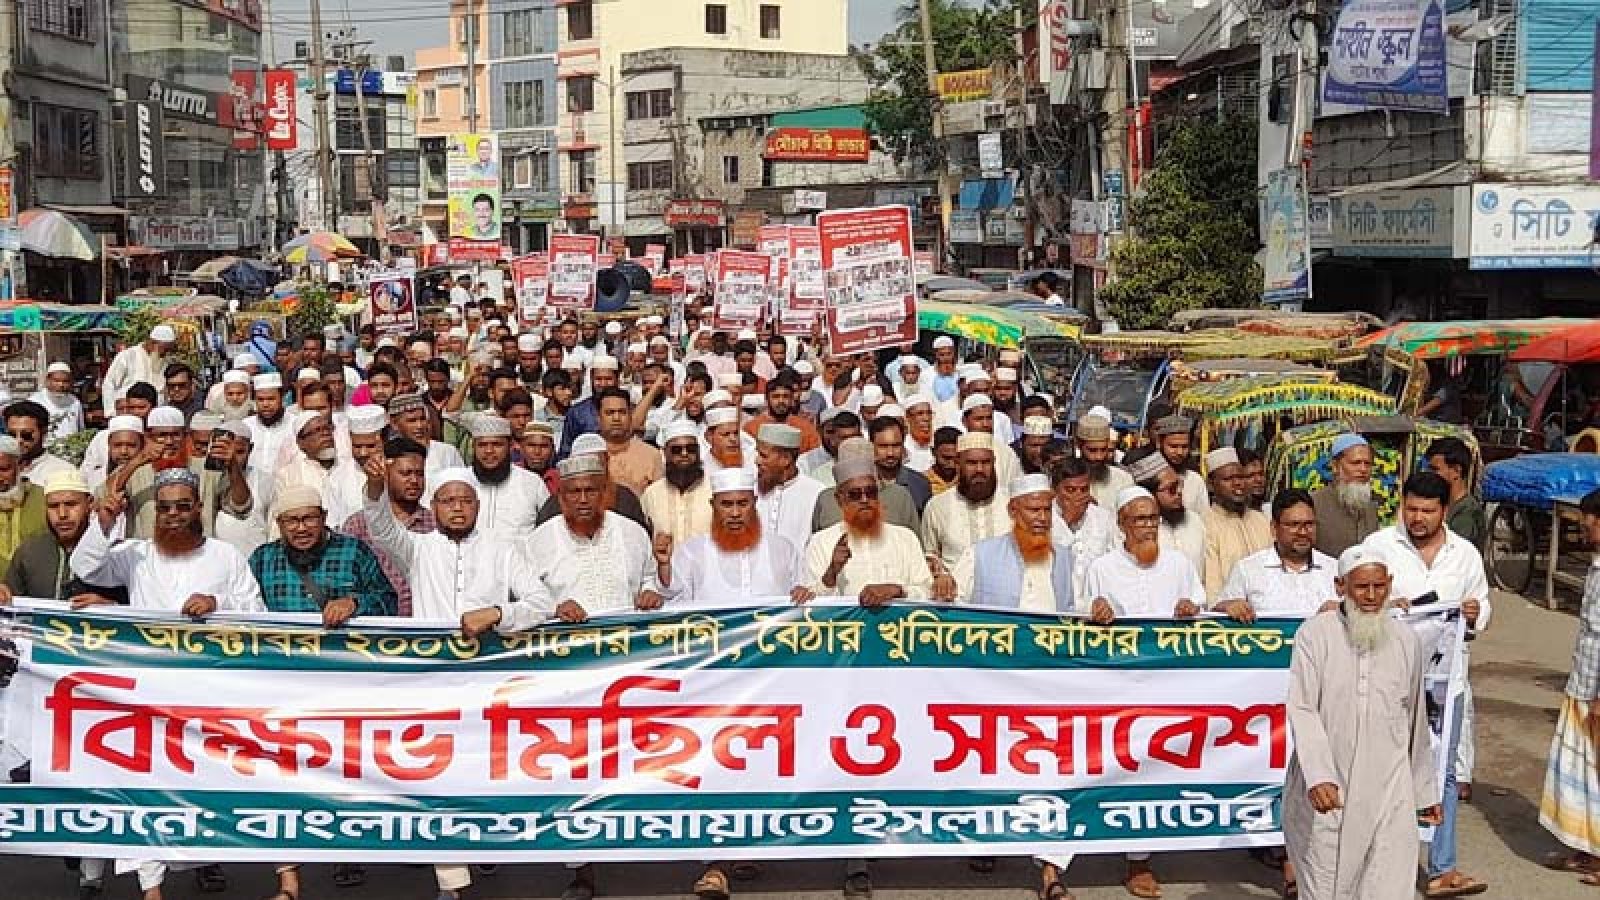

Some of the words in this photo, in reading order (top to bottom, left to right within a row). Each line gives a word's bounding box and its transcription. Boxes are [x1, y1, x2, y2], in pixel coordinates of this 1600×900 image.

[163, 87, 207, 116] LOTTO
[137, 103, 152, 174] LOTTO
[1347, 200, 1378, 236] সিটি
[1508, 198, 1576, 240] সিটি
[45, 619, 118, 656] ২৮
[135, 622, 323, 657] অক্টোবর
[345, 631, 481, 660] ২০০৬
[501, 627, 632, 658] সালের
[755, 609, 865, 654] বৈঠার
[878, 610, 1019, 662] খুনিদের
[45, 671, 461, 780] বিক্ষোভ
[483, 675, 803, 789] মিছিল
[829, 703, 902, 777] ও
[927, 703, 1287, 776] সমাবেশ
[233, 808, 544, 841] বাংলাদেশ
[553, 806, 838, 843] জামায়াতে
[849, 794, 1087, 838] ইসলামী,
[1098, 789, 1274, 831] নাটোর
